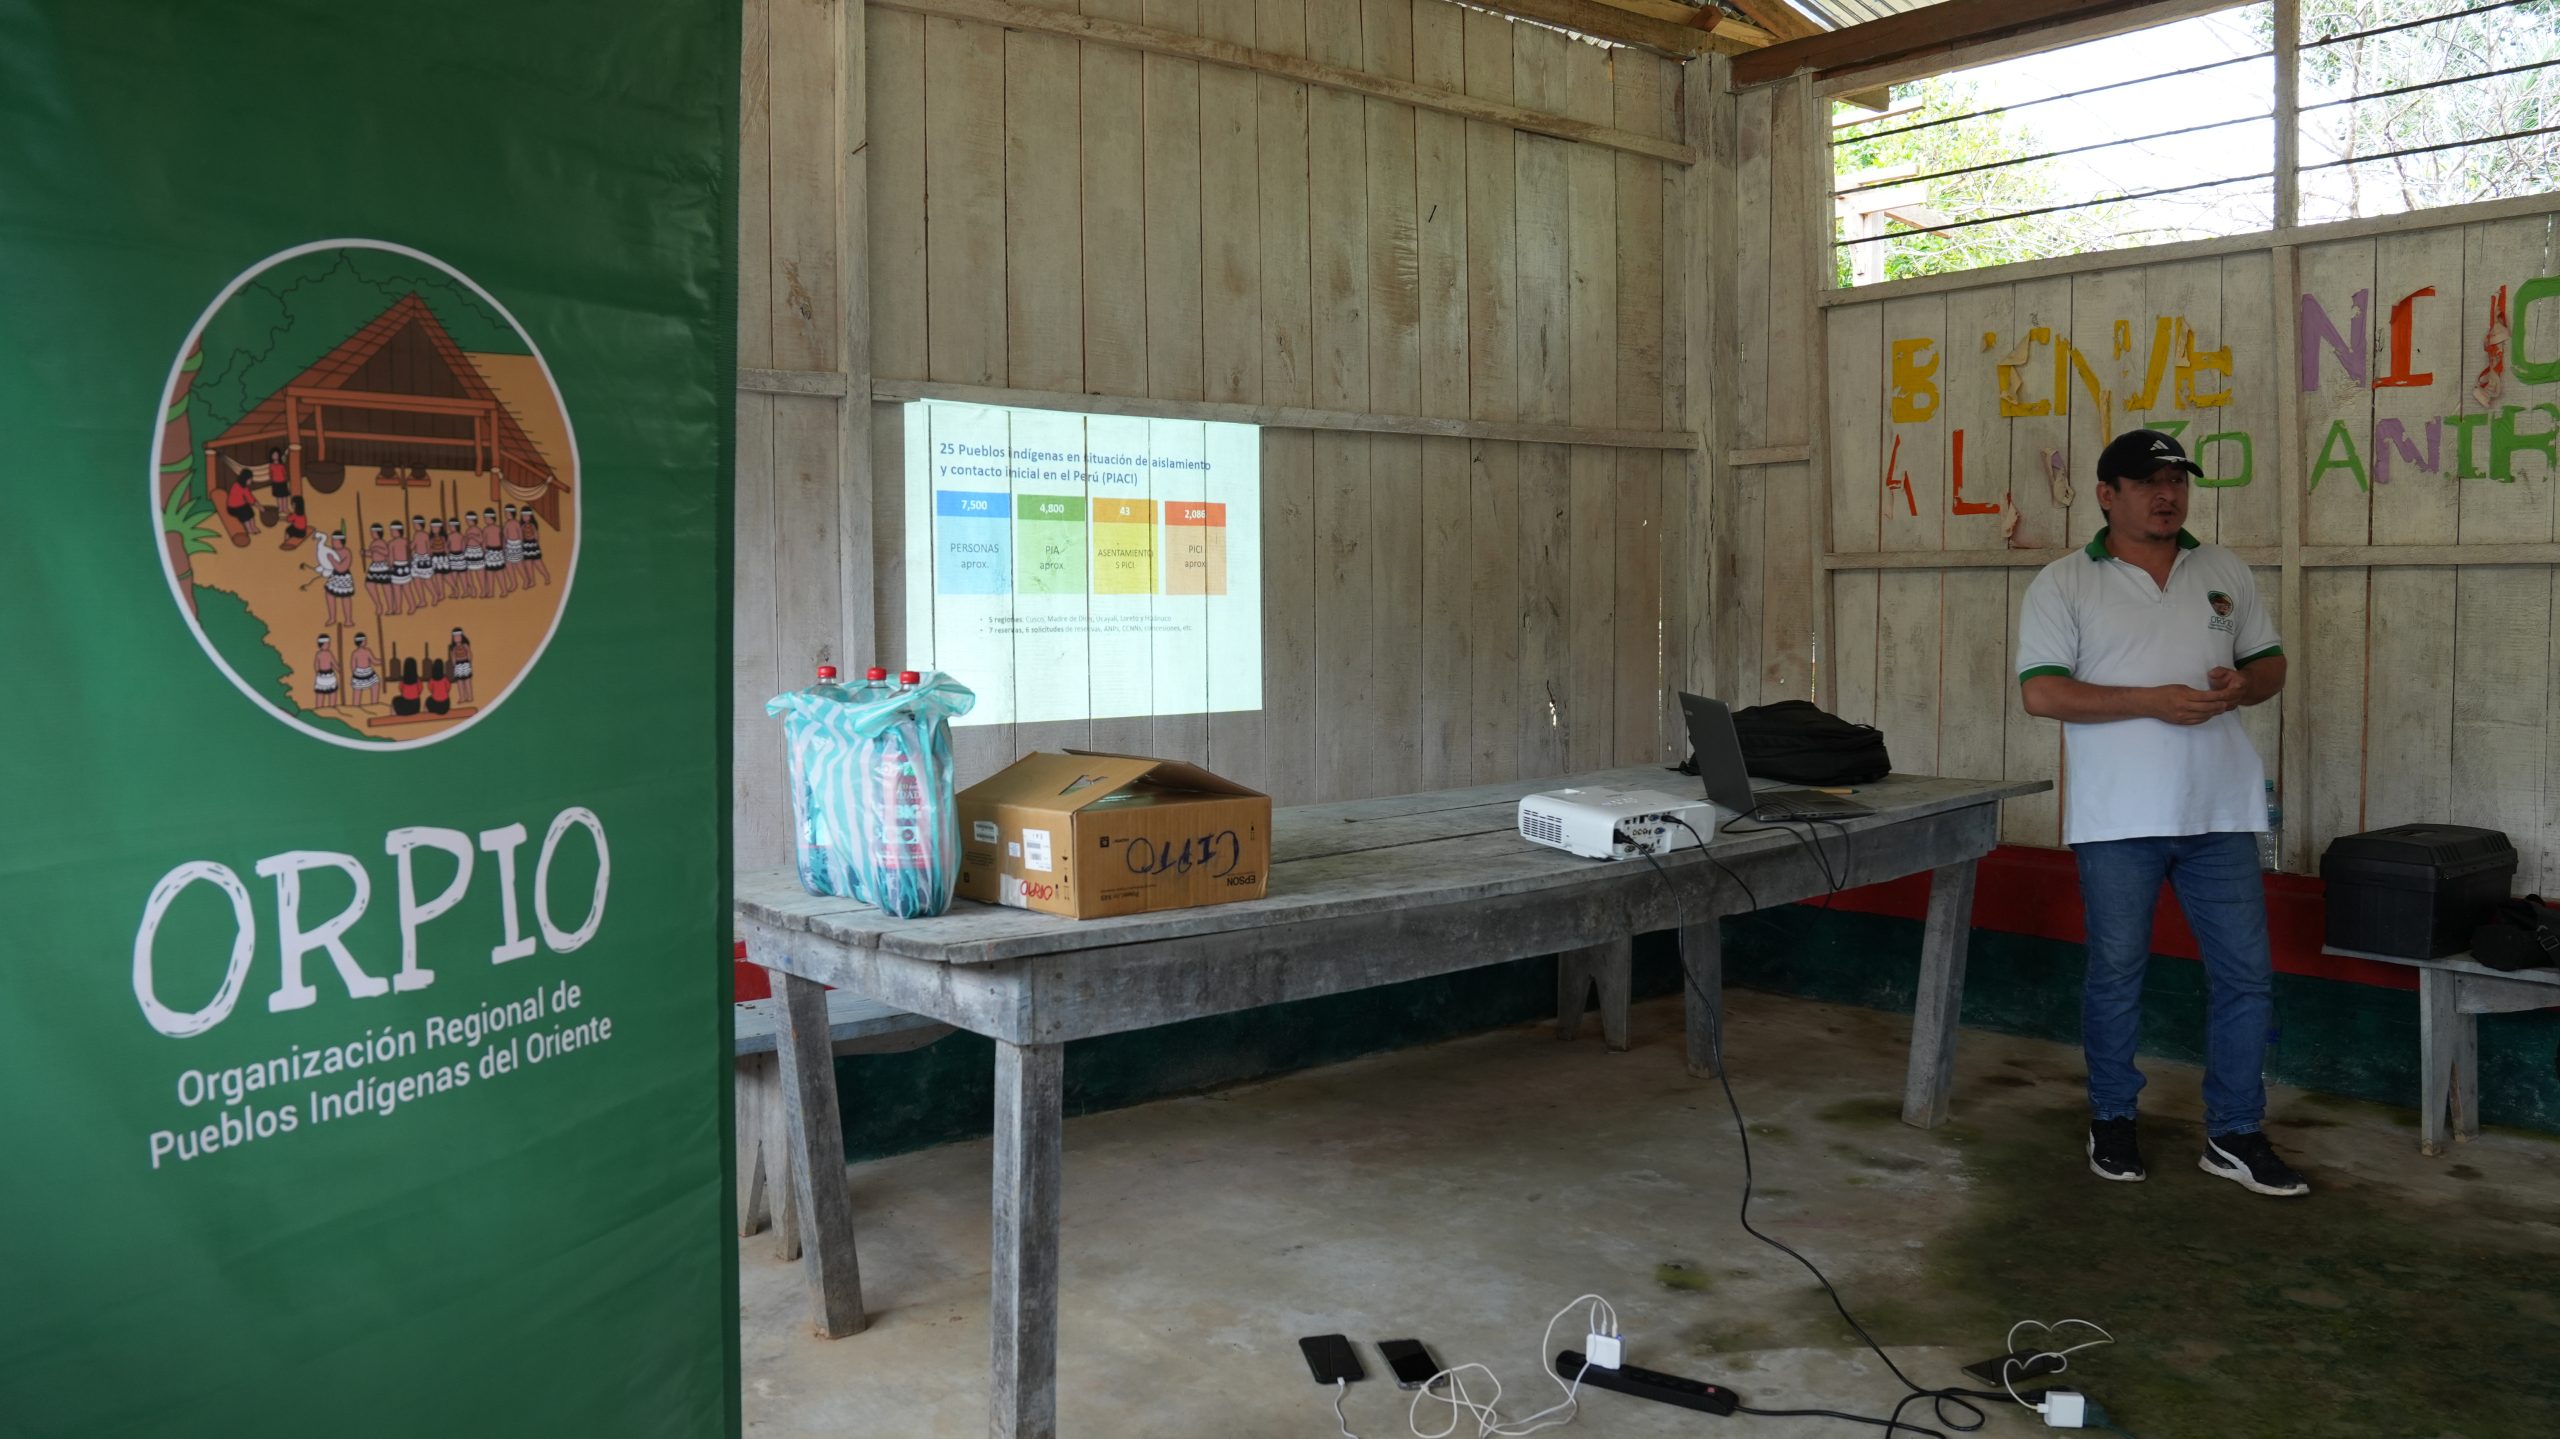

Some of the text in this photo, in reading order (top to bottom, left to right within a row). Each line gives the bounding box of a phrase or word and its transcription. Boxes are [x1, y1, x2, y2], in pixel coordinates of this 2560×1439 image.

[940, 443, 955, 454] 25
[959, 444, 1005, 458] Pueblos
[1067, 453, 1080, 462] en
[1135, 455, 1148, 466] de
[1152, 457, 1211, 470] aislamiento
[940, 465, 1138, 487] y contacto inicial en el Perú (PIACI)
[961, 500, 988, 511] 7,500
[1039, 504, 1065, 514] 4,800
[950, 543, 999, 553] PERSONAS
[1045, 545, 1060, 555] PIA
[1188, 545, 1203, 554] PICI
[960, 561, 990, 570] aprox.
[1226, 874, 1256, 887] EPSON
[133, 806, 610, 1038] ORPIO
[177, 980, 582, 1107] Organización Regional de
[149, 1014, 612, 1169] Pueblos Indígenas del Oriente
